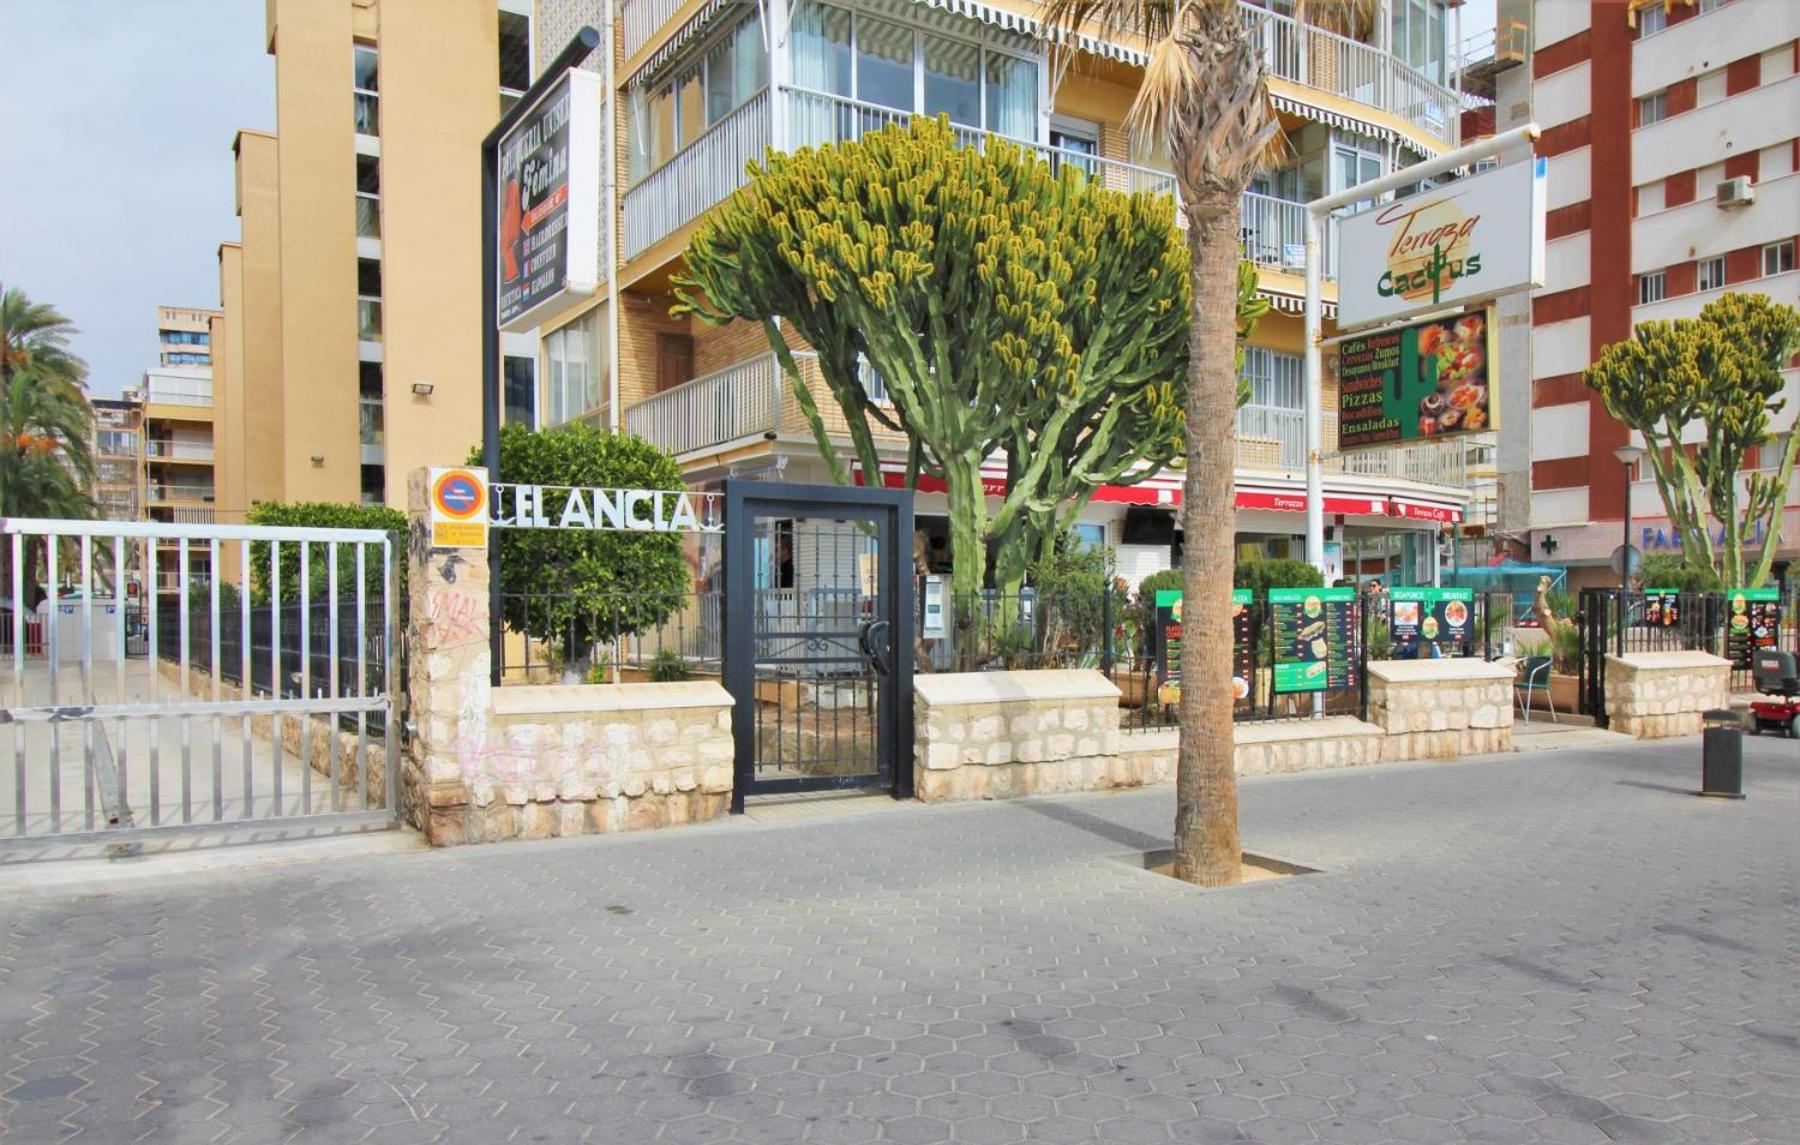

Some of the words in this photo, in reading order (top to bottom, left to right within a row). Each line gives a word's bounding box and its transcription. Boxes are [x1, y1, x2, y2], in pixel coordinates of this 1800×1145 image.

[1376, 190, 1481, 257] Terraza
[1342, 391, 1383, 408] Pizzas
[1342, 417, 1399, 434] Ensaladas
[516, 485, 550, 528] EL
[559, 487, 700, 531] ANCLA
